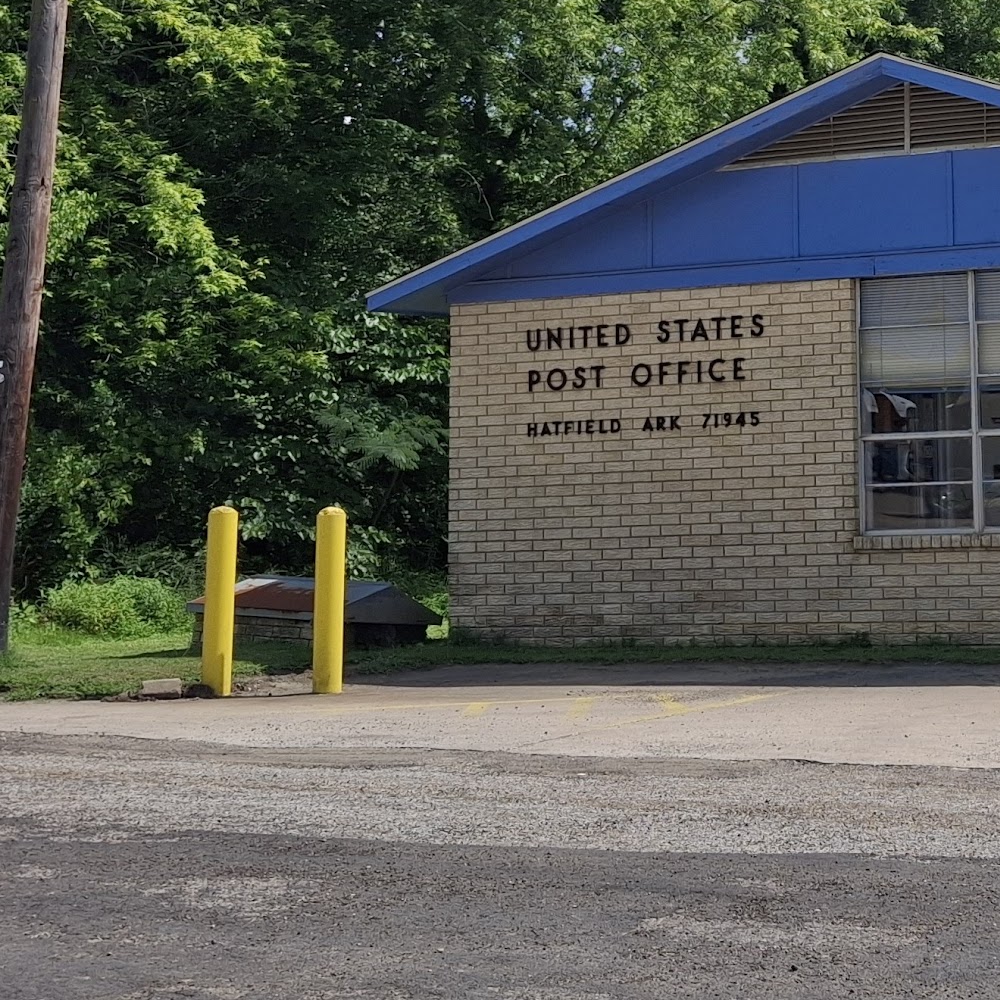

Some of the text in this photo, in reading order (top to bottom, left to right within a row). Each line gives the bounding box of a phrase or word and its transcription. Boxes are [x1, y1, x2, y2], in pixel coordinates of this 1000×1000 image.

[526, 314, 765, 351] UNITED STATES
[528, 357, 746, 392] POST OFFICE
[527, 411, 760, 437] HATFIELD ARK 71945
